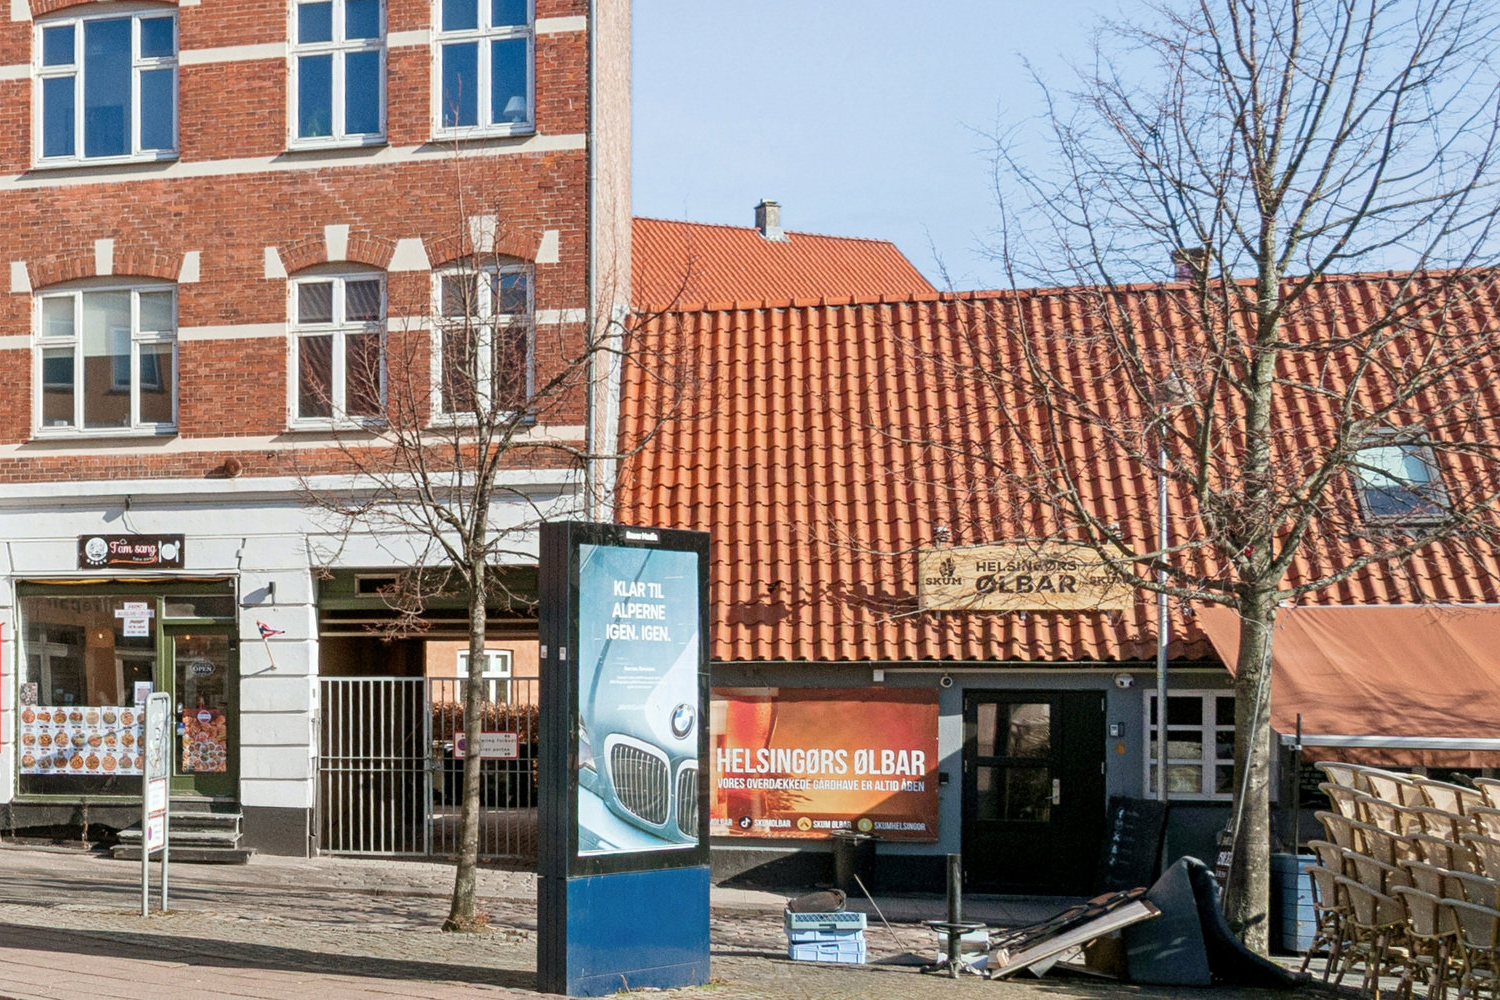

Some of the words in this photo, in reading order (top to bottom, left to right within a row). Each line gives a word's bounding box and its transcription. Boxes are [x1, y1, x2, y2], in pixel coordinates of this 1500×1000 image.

[134, 544, 157, 557] sang
[975, 560, 1077, 573] HELSINGØRS
[613, 580, 646, 598] KLAR
[647, 582, 665, 599] TIL
[925, 577, 962, 586] SKUM
[975, 573, 1077, 594] ØLBAR
[612, 602, 666, 620] ALPERNE
[606, 623, 639, 640] IGEN.
[642, 625, 671, 642] IGEN.
[192, 665, 213, 673] OPEN
[716, 747, 848, 775] HELSINGØRS
[854, 748, 926, 776] ØLBAR
[717, 778, 745, 789] VORES
[746, 778, 811, 790] OVERDÆKKEDE
[813, 778, 859, 791] GÅRDHAVE
[861, 780, 872, 791] ER
[874, 780, 899, 792] ALTID
[901, 778, 925, 792] ÅBEN
